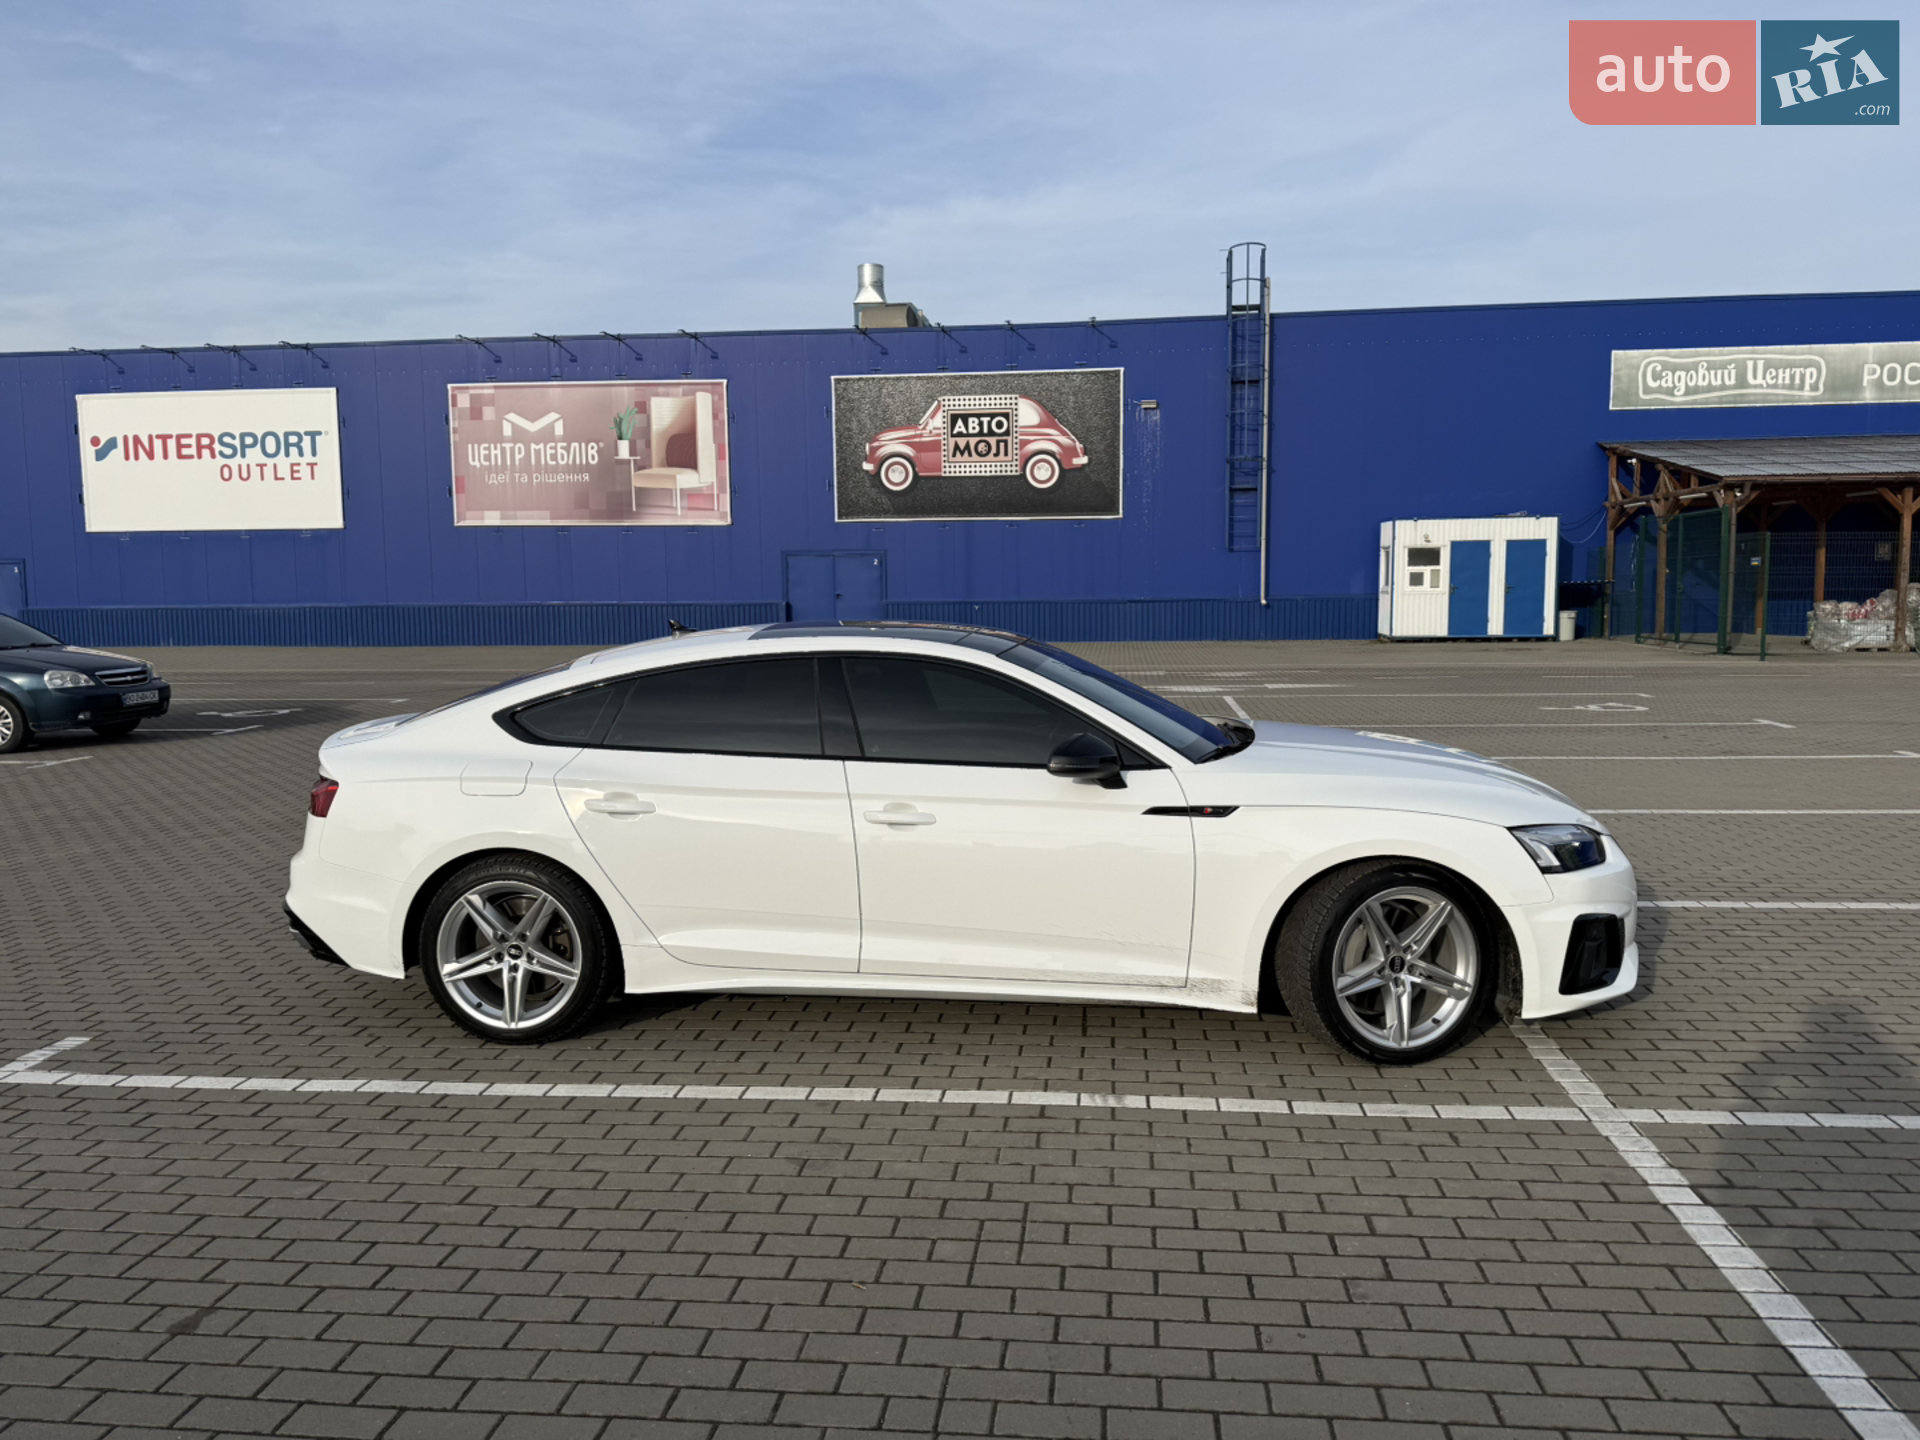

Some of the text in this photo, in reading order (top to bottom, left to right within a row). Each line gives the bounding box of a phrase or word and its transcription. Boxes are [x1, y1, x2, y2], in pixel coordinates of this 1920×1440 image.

[1645, 360, 1818, 396] Садовий Центр
[952, 416, 1008, 434] АВТО
[123, 430, 323, 462] INTERSPORT
[467, 442, 599, 468] ЦЕНТР МЕБЛІВ
[951, 439, 1008, 458] МОЛ
[219, 462, 318, 482] OUTLET
[484, 471, 590, 485] ідеї та рішення
